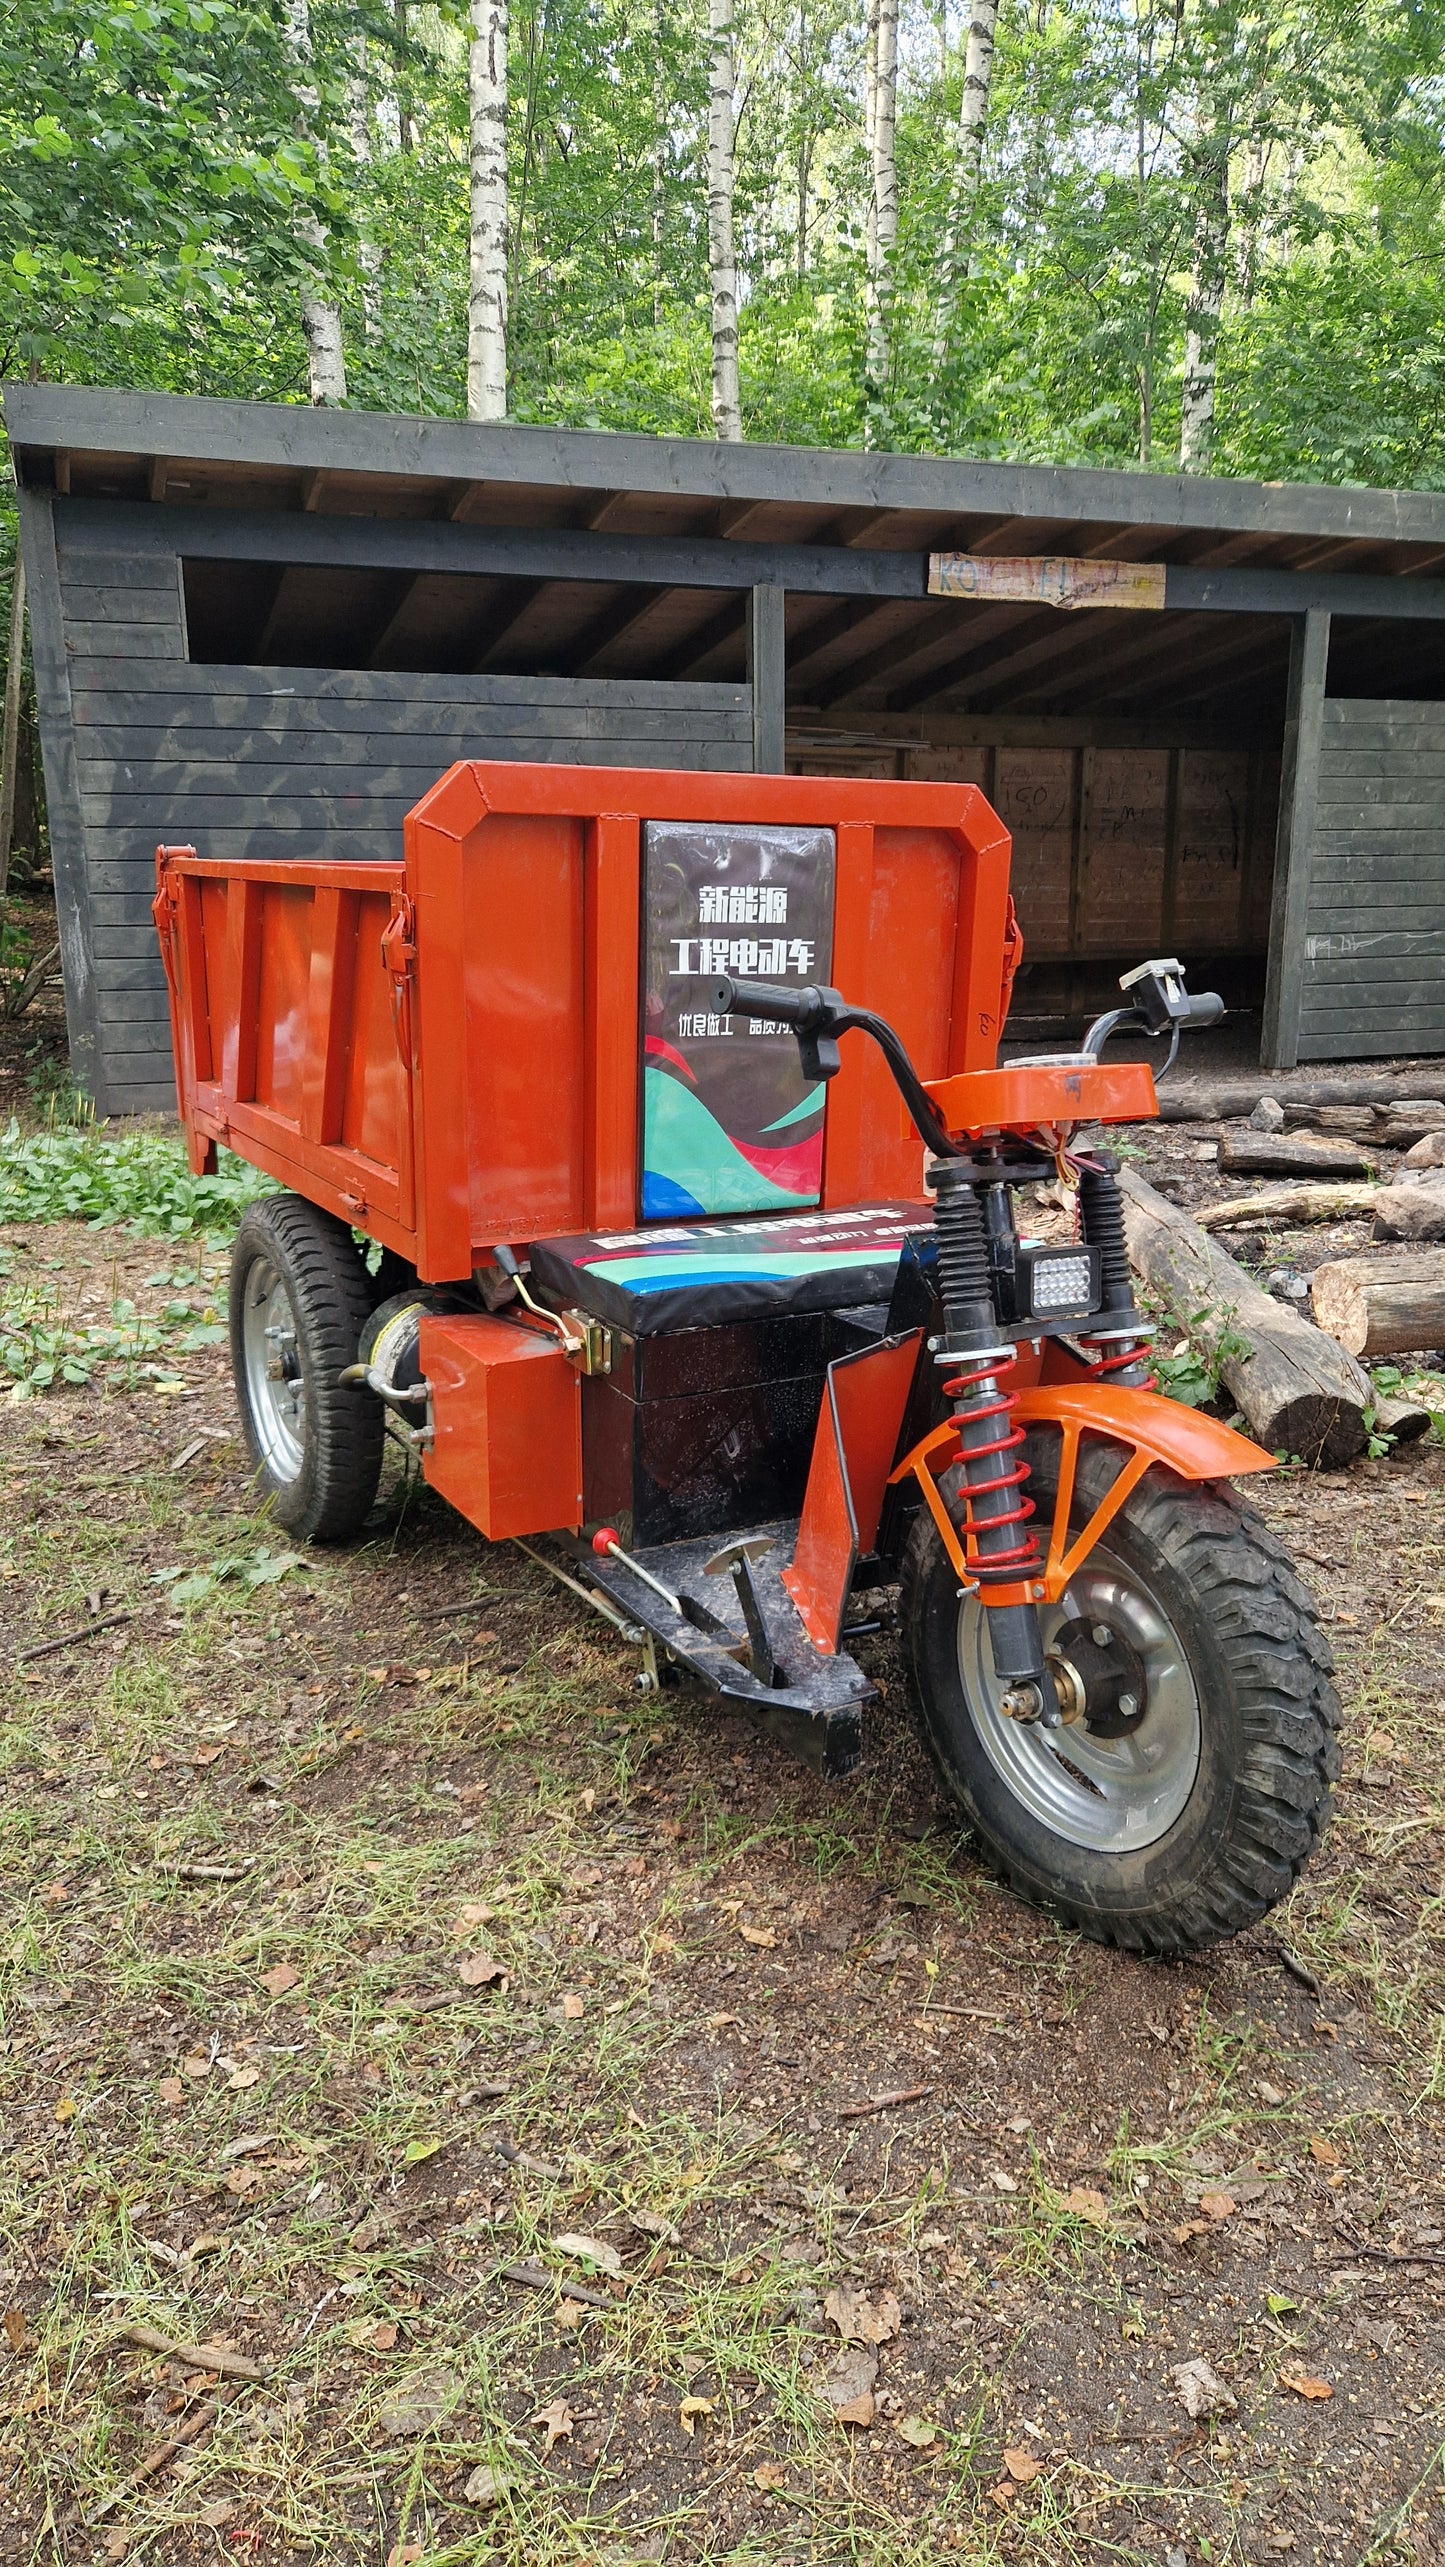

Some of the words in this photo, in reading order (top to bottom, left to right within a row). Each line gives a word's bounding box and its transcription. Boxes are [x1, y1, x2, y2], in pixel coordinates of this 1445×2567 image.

[699, 885, 788, 924] 新能源
[669, 938, 815, 975] 工程电动车
[678, 1013, 734, 1037] 优良做工
[749, 1018, 794, 1035] 品质为
